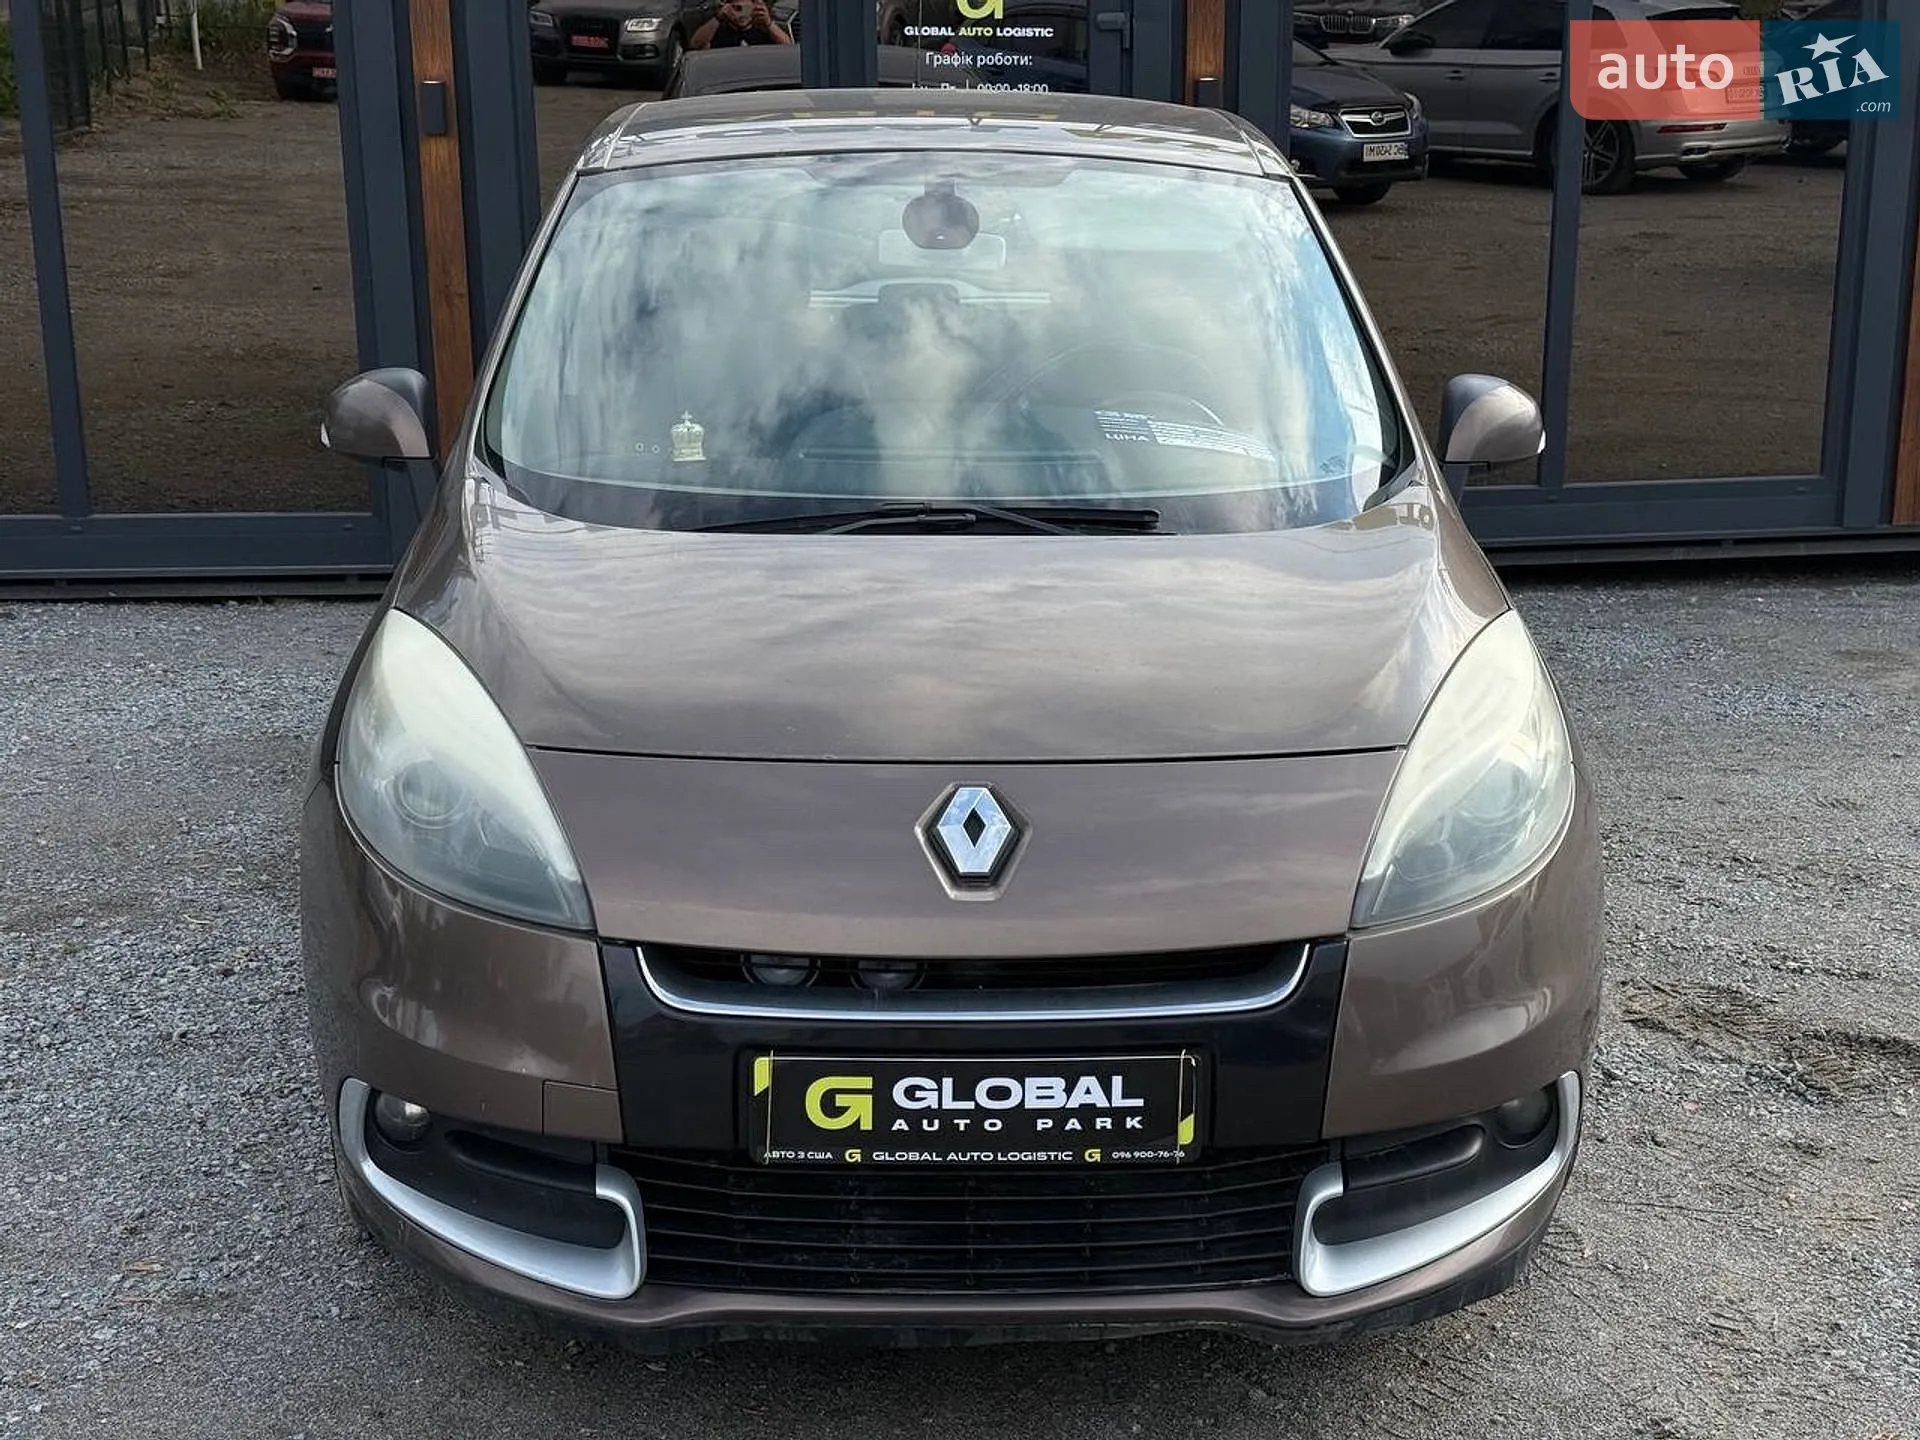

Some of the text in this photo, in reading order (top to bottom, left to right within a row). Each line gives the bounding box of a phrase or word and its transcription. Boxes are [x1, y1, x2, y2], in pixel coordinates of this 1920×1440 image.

[904, 26, 1054, 37] GLOBAL AUTO LOGISTIC
[925, 52, 1033, 68] Графік роботи:
[892, 1076, 1144, 1110] GLOBAL
[891, 1116, 1143, 1131] AUTO PARK
[764, 1151, 794, 1159] АВТО
[807, 1151, 833, 1159] США
[872, 1152, 942, 1161] GLOBAL
[946, 1152, 994, 1161] AUTO
[998, 1151, 1073, 1161] LOGISTIC
[1112, 1151, 1185, 1159] 096 900-76-76
